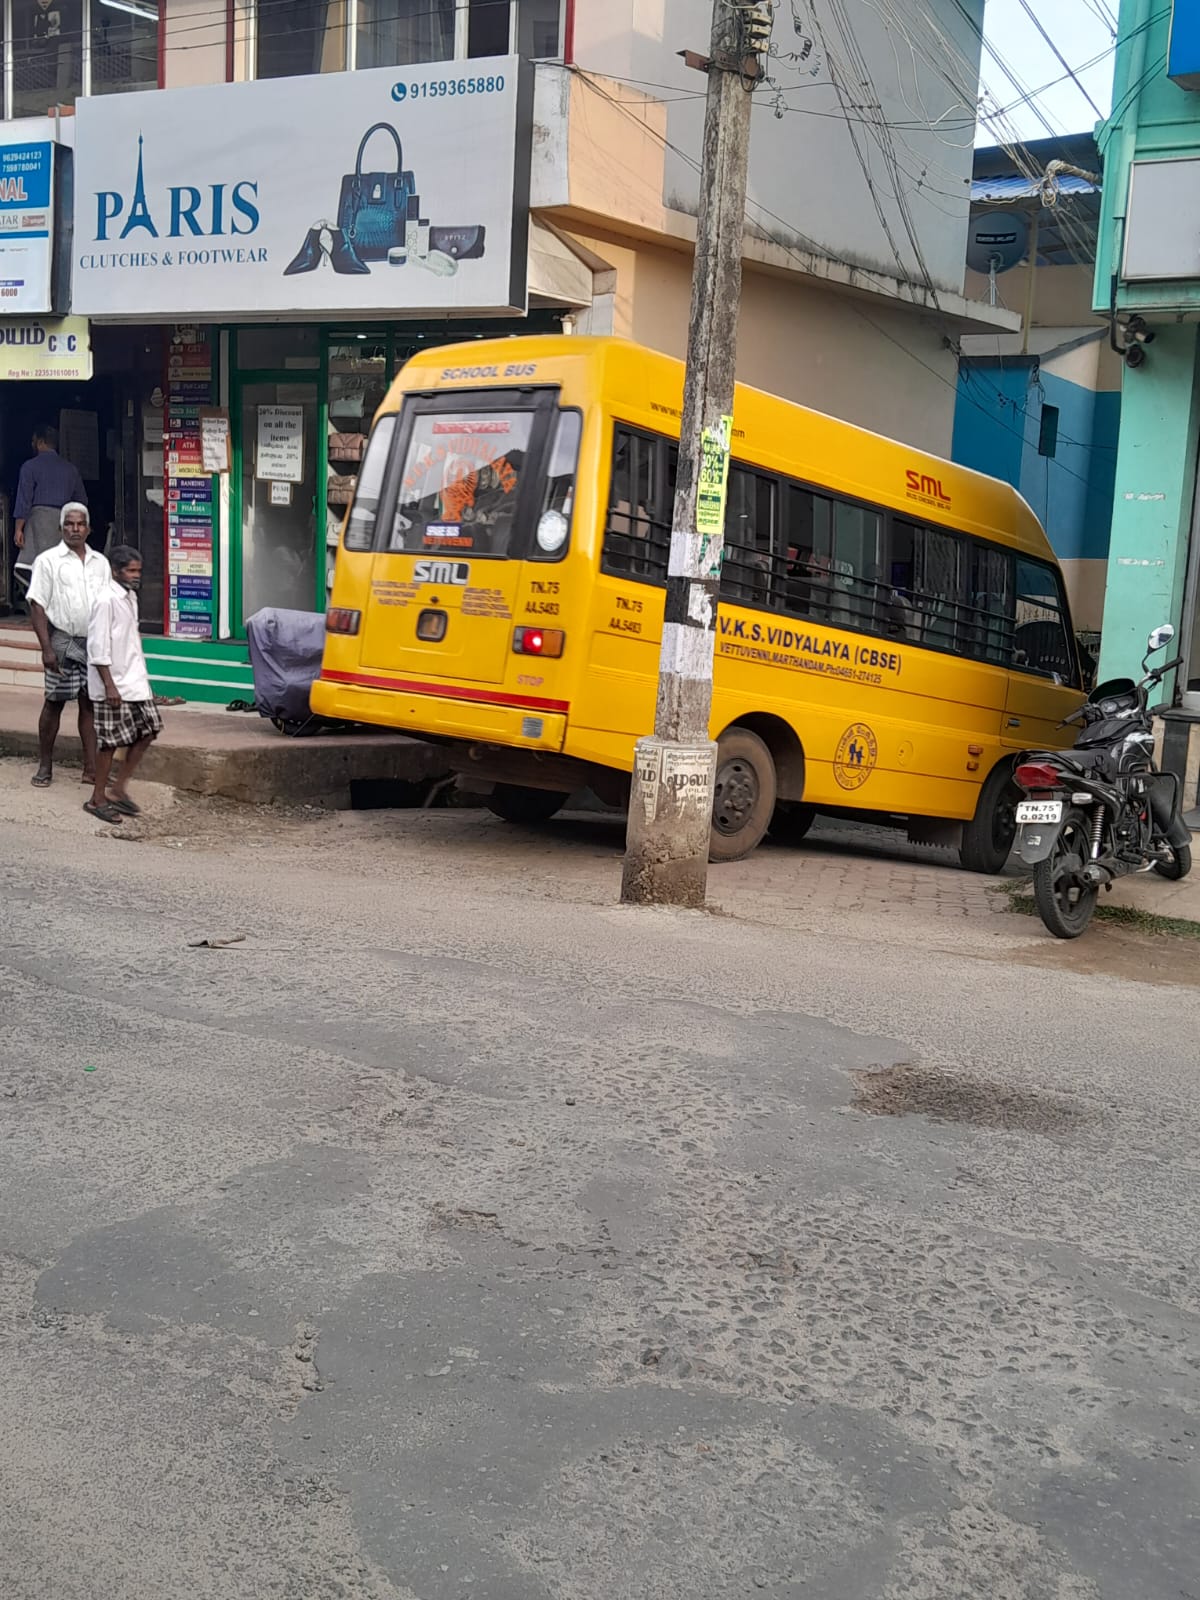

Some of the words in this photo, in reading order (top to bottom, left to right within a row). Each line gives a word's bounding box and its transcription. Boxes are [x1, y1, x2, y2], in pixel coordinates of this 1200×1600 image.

[410, 75, 505, 99] 9159365880
[92, 128, 260, 241] PARIS
[80, 252, 158, 269] CLUTCHES
[162, 252, 173, 266] &
[178, 247, 268, 265] FOOTWEAR
[441, 366, 499, 380] SCHOOL
[503, 364, 537, 377] BUS
[274, 421, 283, 429] all
[271, 434, 290, 442] items
[905, 469, 952, 502] SML
[413, 560, 470, 585] SML
[531, 581, 560, 594] TN.75
[616, 597, 643, 613] TN.75
[854, 645, 902, 676] (CBSE)
[517, 674, 545, 686] STOP
[1025, 804, 1054, 812] TN.75
[1020, 813, 1057, 821] Q.0219
